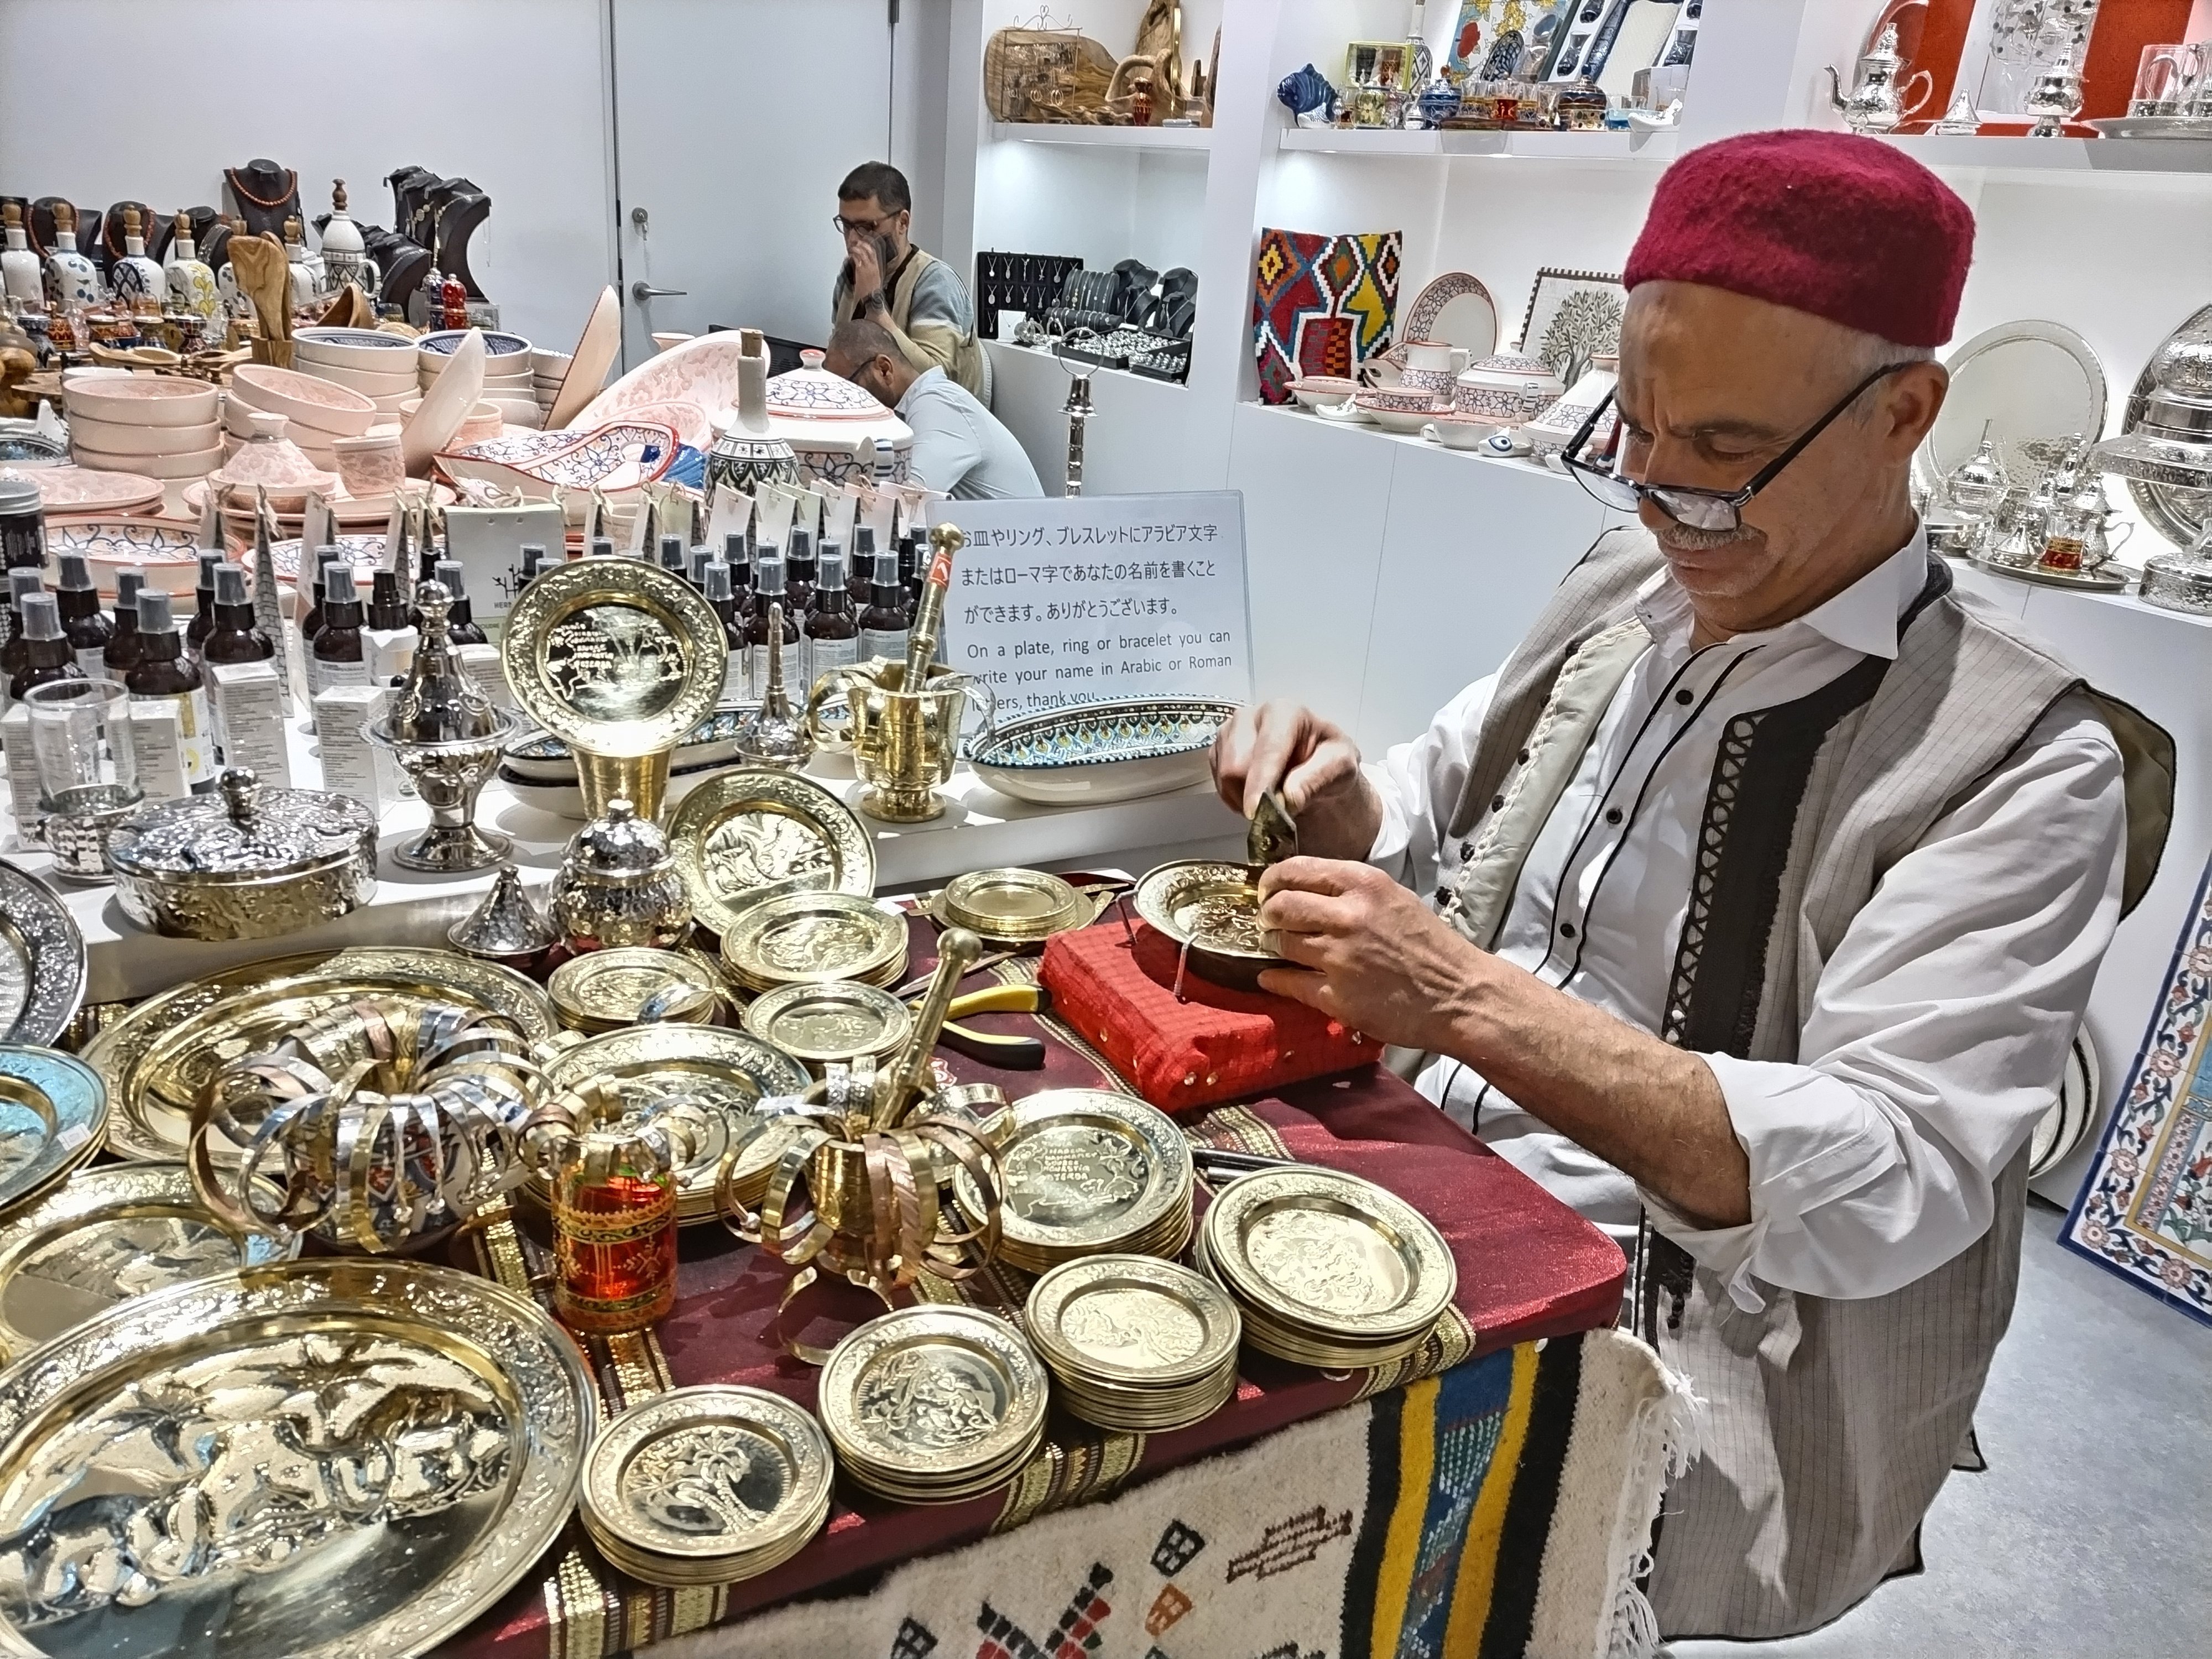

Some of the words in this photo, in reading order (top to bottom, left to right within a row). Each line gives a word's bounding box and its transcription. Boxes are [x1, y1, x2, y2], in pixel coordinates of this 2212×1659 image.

[961, 559, 1216, 586] またはローマ字であなたの名前を書くこと
[964, 597, 1177, 624] ができます。ありがとうございます。
[967, 644, 988, 659] On
[997, 645, 1005, 657] a
[1014, 640, 1055, 659] plate,
[1062, 638, 1089, 655] ring
[1097, 639, 1112, 650] or
[1119, 632, 1172, 649] bracelet
[1178, 634, 1202, 648] you
[1209, 632, 1230, 643] can
[973, 670, 1008, 685] write
[1015, 669, 1048, 685] your
[1055, 666, 1094, 679] name
[1101, 662, 1113, 676] in
[1120, 658, 1162, 675] Arabic
[1168, 660, 1182, 671] or
[1189, 656, 1232, 669] Roman
[1026, 690, 1066, 707] thank
